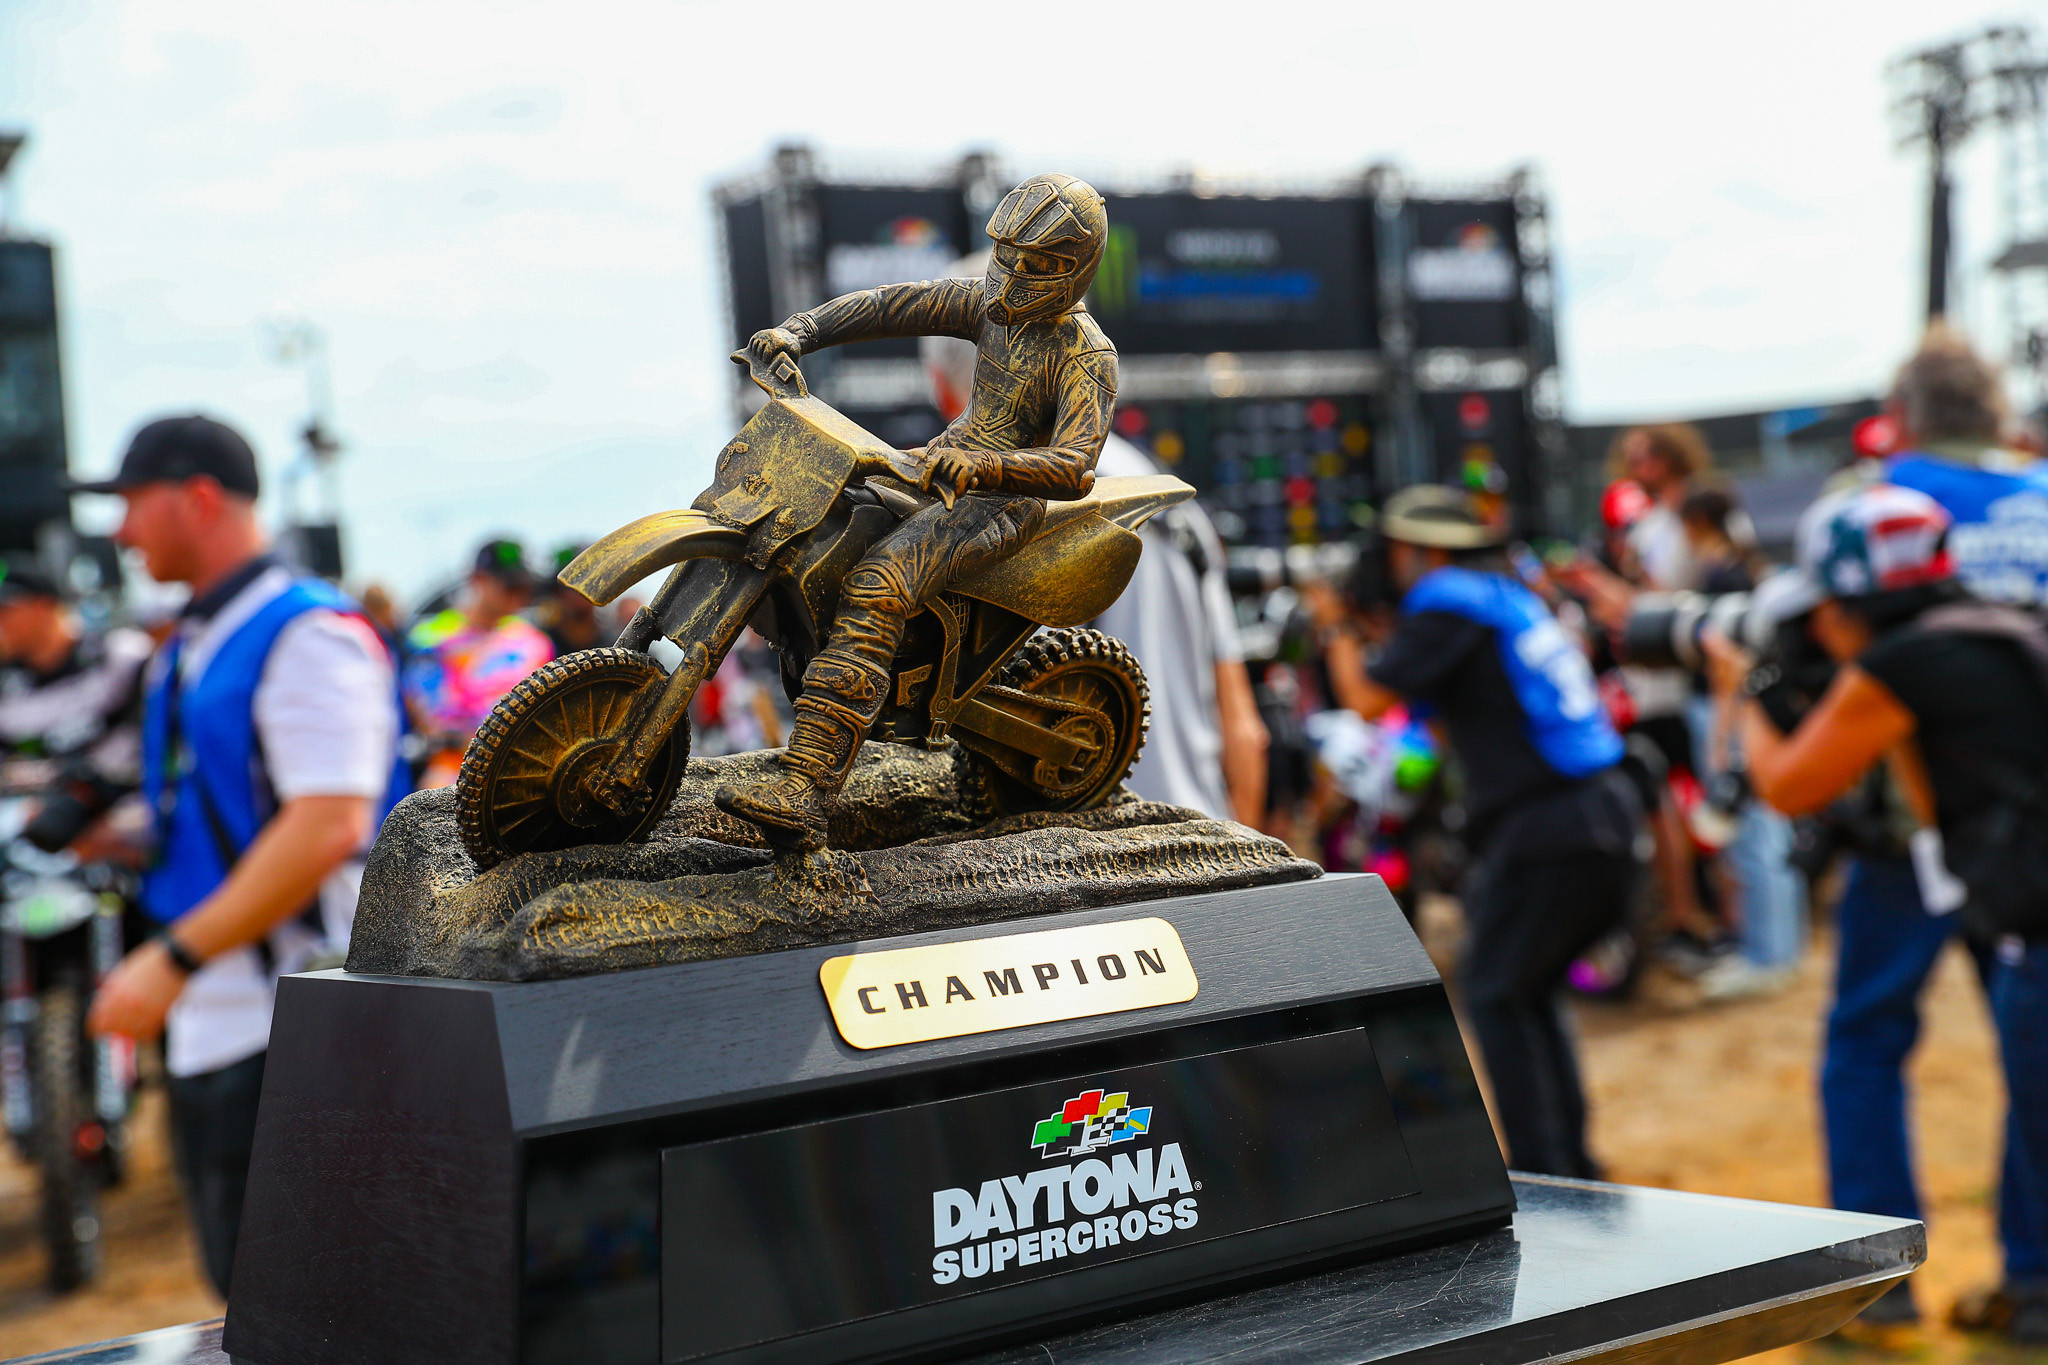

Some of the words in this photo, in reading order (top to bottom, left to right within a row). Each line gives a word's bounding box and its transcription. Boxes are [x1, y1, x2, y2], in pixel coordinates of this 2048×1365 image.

[857, 947, 1167, 1014] CHAMPION
[933, 1142, 1193, 1248] DAYTONA
[932, 1198, 1199, 1285] SUPERCROSS
